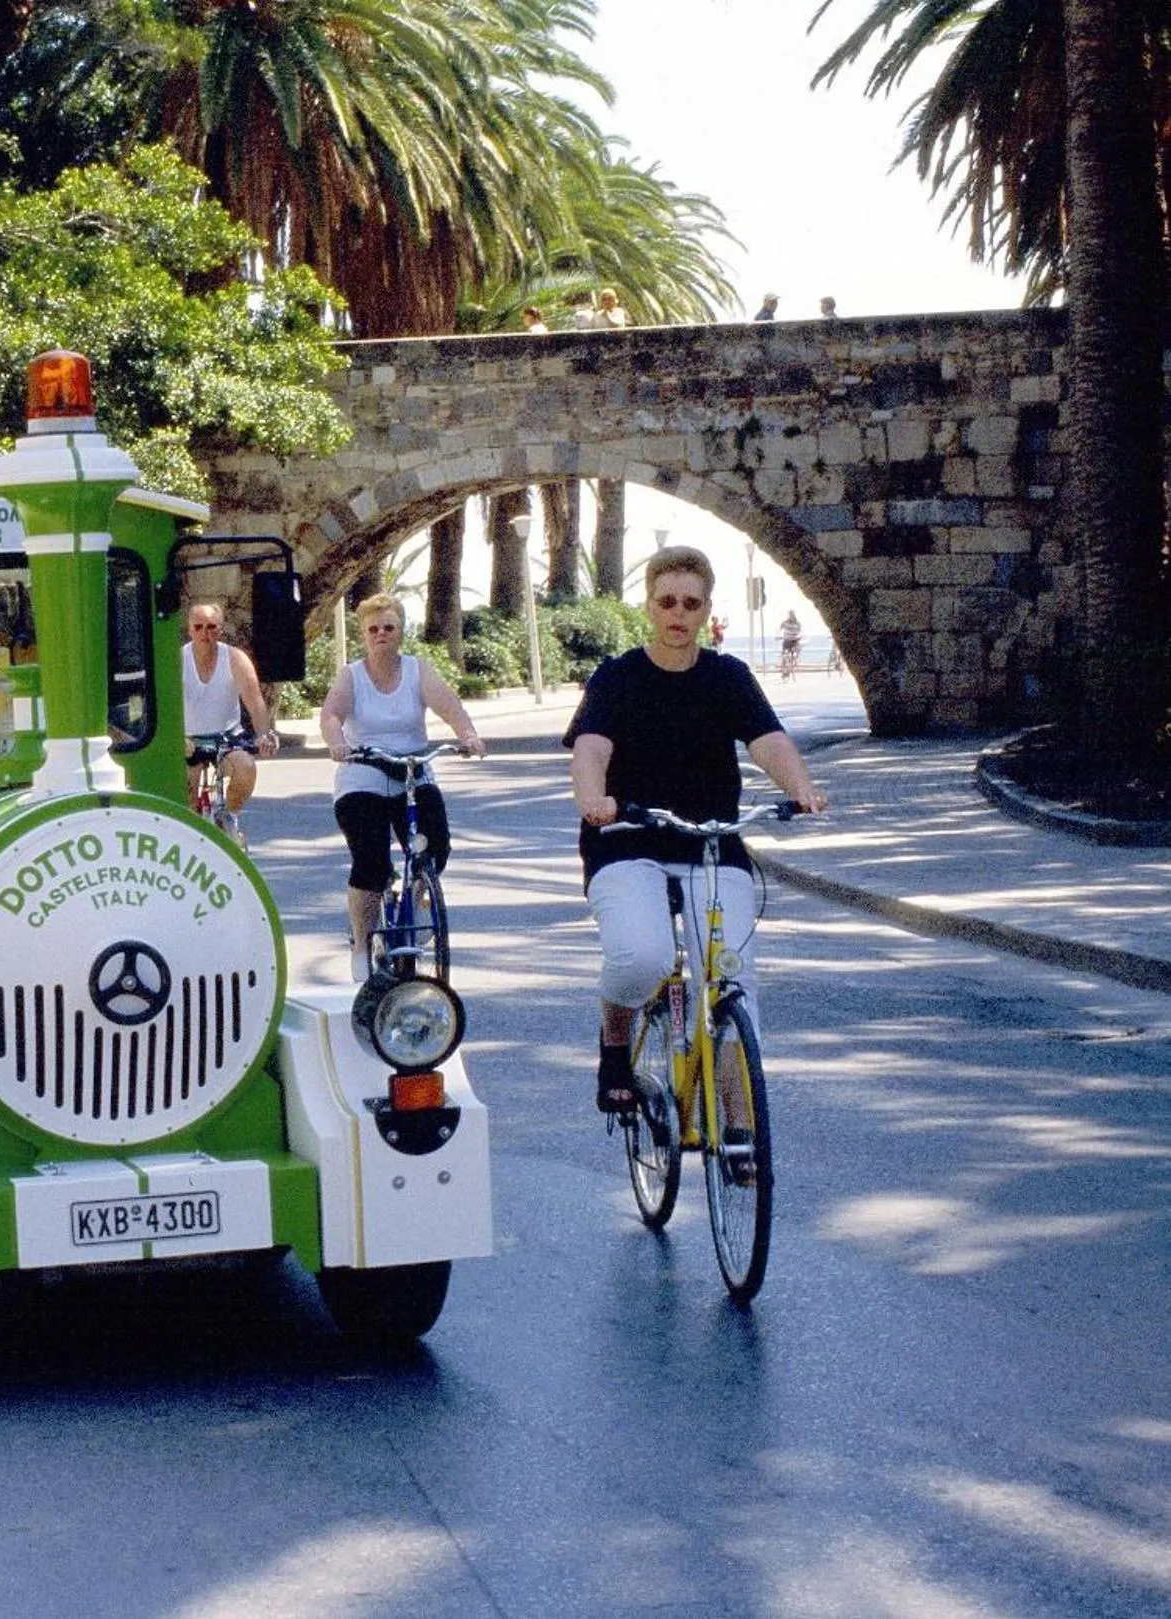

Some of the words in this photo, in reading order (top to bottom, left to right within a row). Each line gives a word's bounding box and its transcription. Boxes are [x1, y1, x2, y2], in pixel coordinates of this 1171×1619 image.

[27, 866, 187, 928] CASTELFRANCO
[192, 903, 208, 926] V.
[92, 890, 149, 911] ITALY
[115, 831, 233, 910] TRAINS
